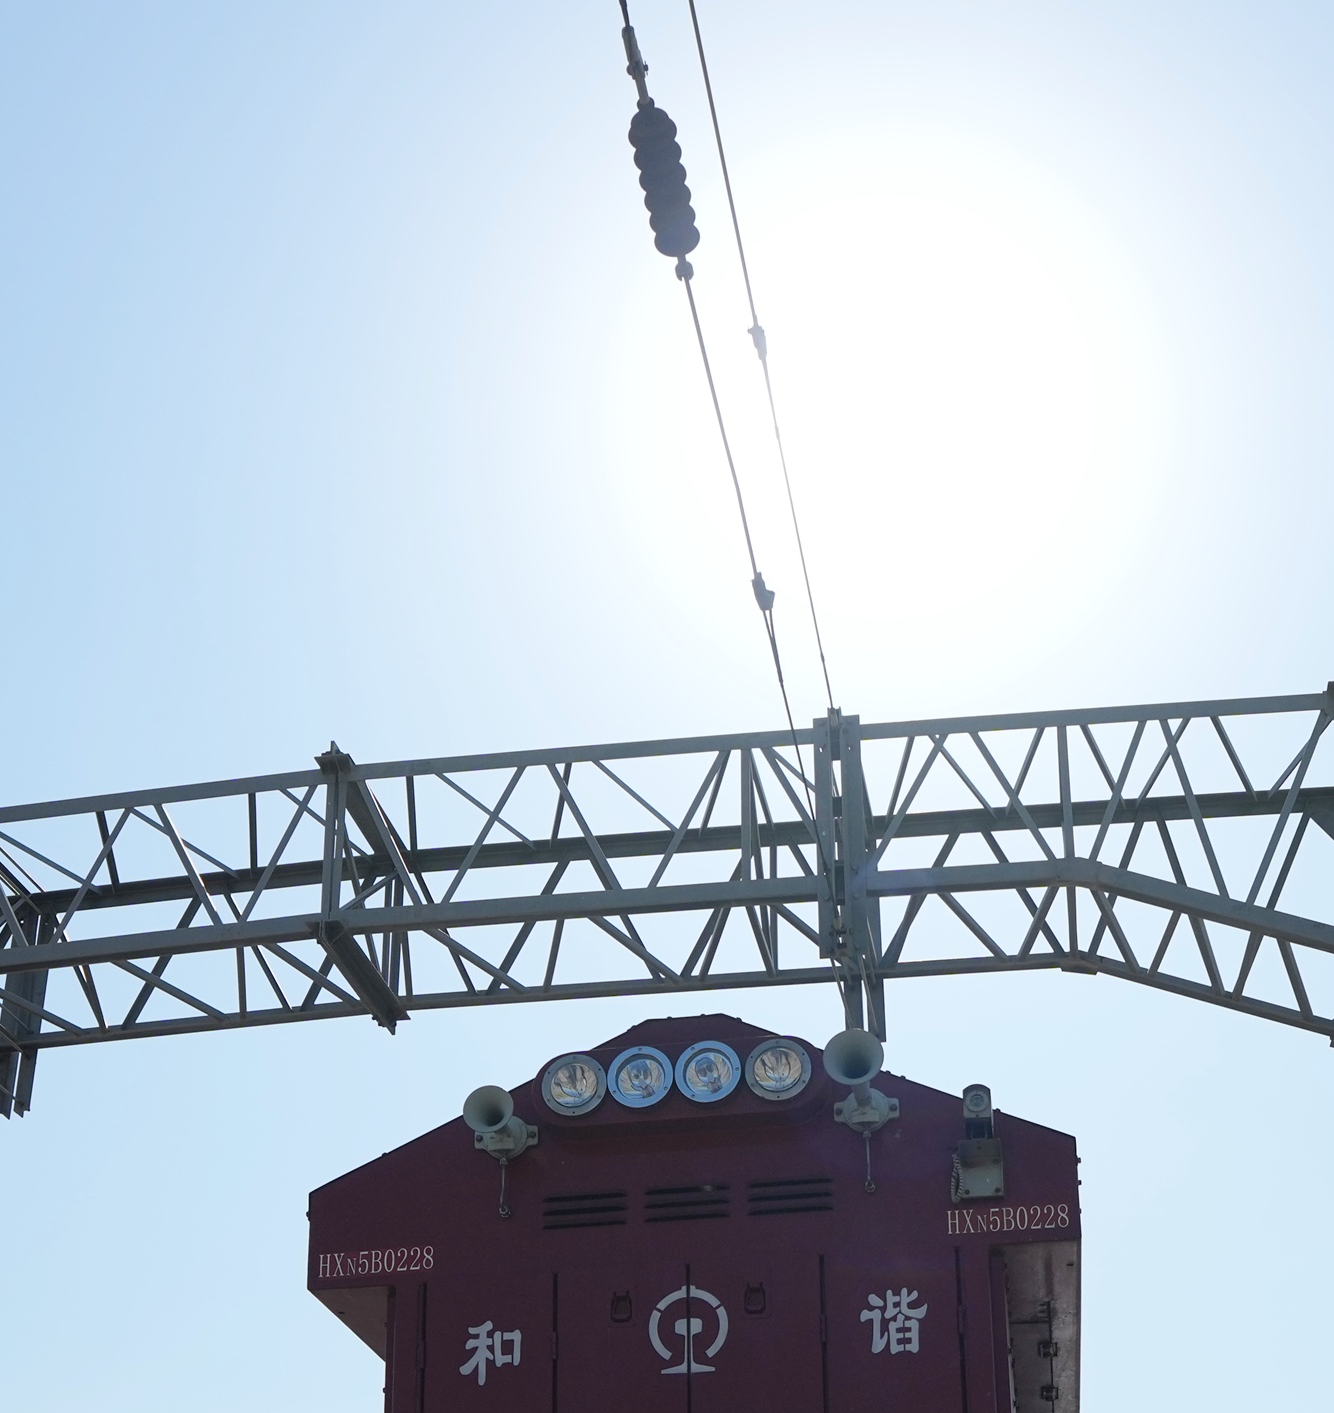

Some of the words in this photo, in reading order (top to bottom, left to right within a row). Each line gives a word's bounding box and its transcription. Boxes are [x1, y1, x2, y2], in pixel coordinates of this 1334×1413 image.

[947, 1204, 1069, 1235] HXN5B0228
[318, 1246, 434, 1278] HXN5B0228
[459, 1320, 522, 1386] 和
[860, 1287, 928, 1355] 谐
